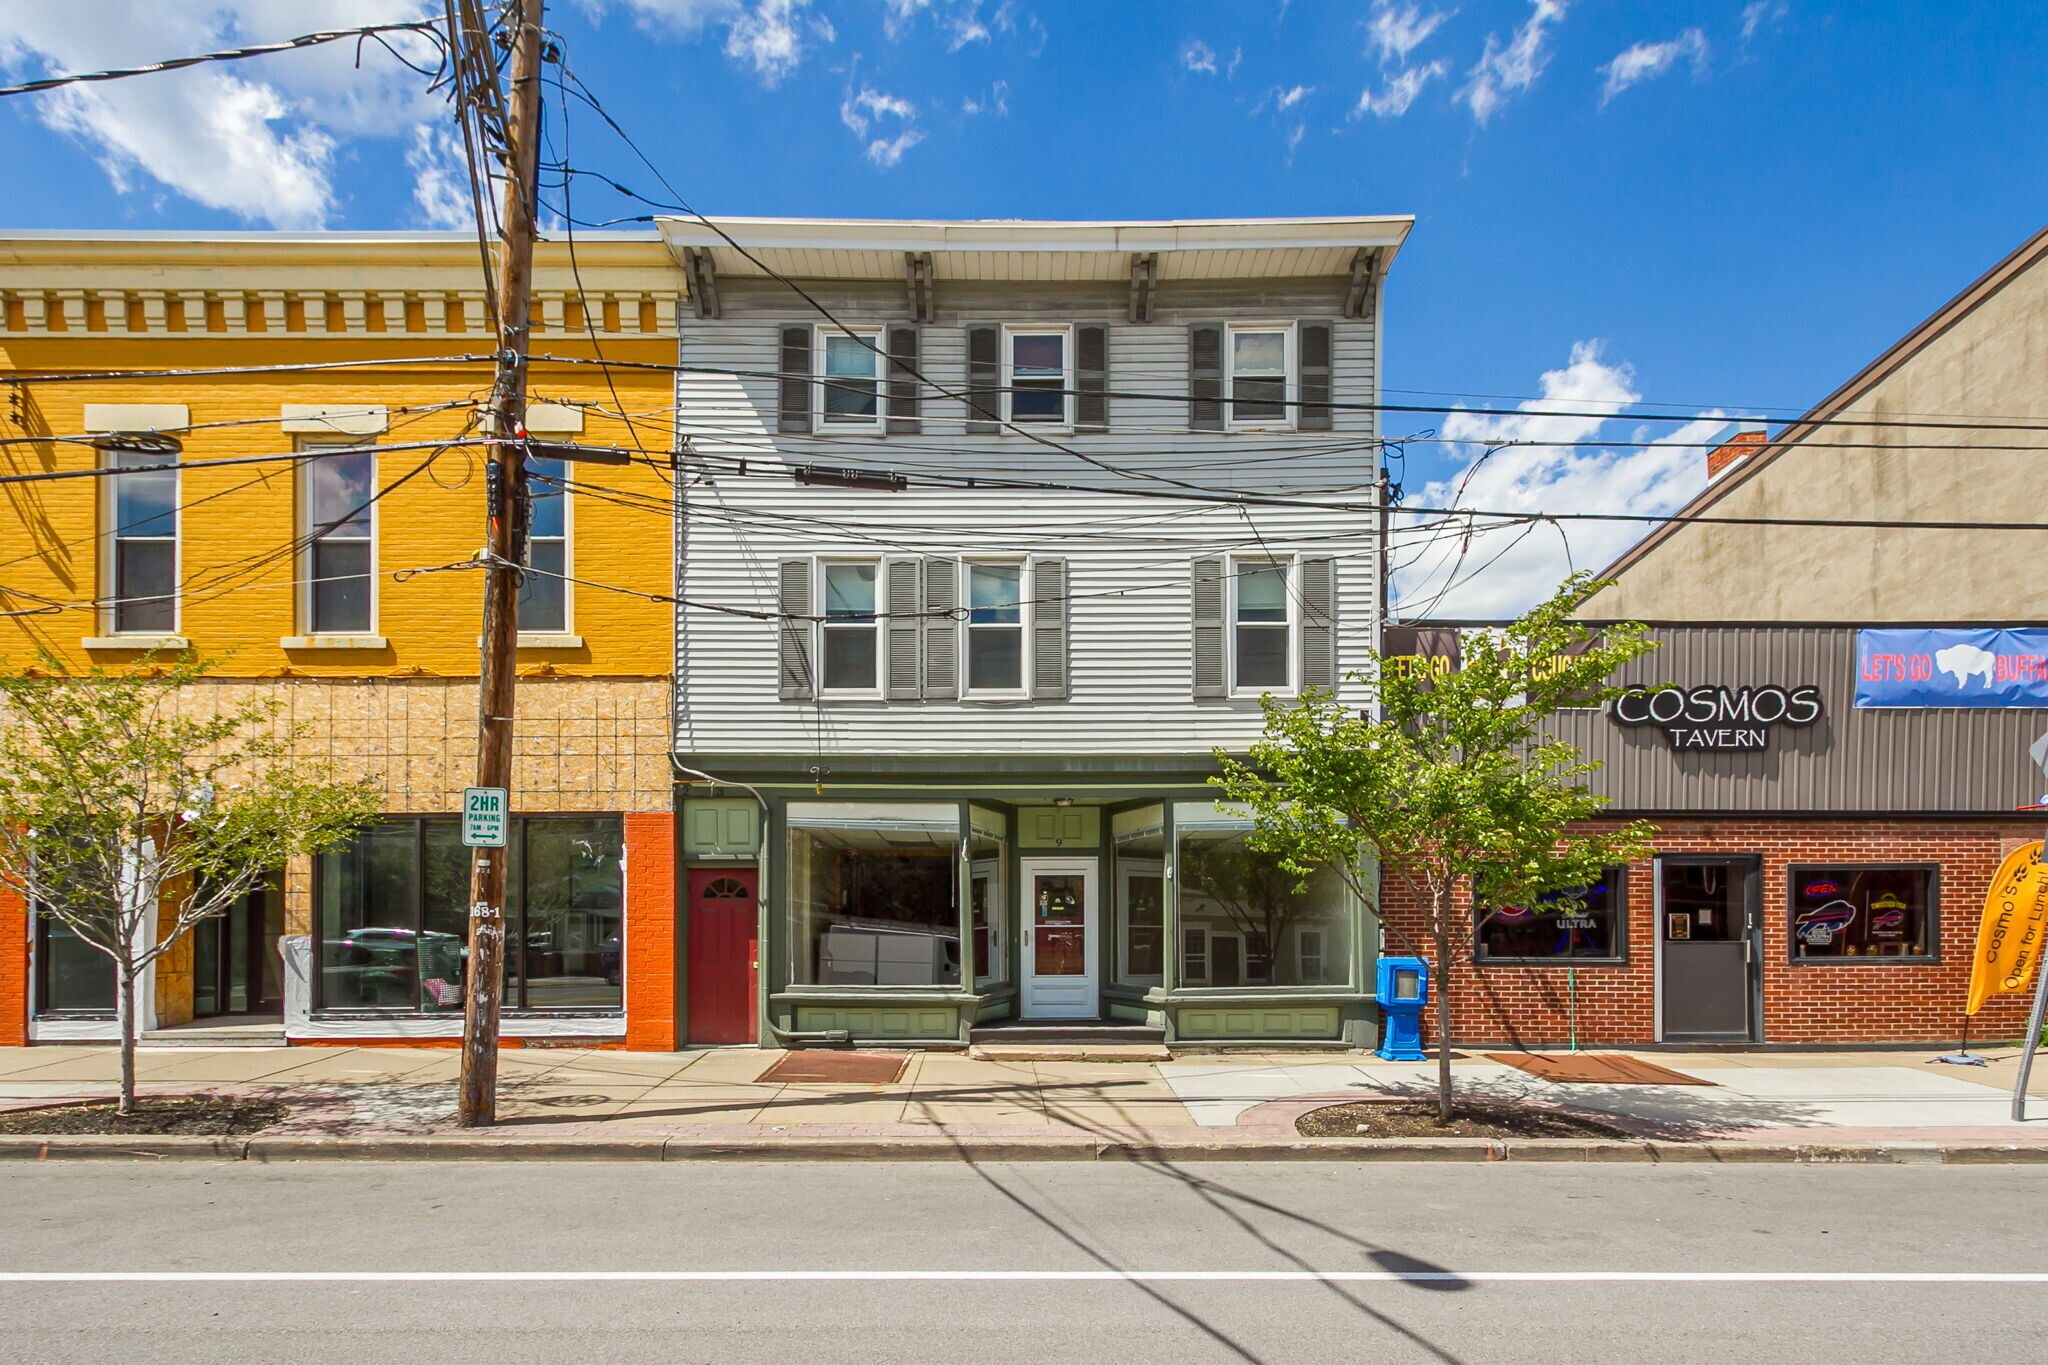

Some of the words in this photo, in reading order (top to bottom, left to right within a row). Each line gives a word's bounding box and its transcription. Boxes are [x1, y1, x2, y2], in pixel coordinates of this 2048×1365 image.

[1430, 655, 1450, 681] GO
[1862, 654, 1906, 681] LET'S
[1909, 654, 1932, 681] GO
[1617, 689, 1820, 722] COSMOS
[1669, 729, 1765, 747] TAVERN
[470, 795, 499, 811] 2HR
[468, 814, 500, 822] PARKING
[1056, 837, 1063, 847] 9
[1804, 883, 1838, 896] OPEN
[1556, 918, 1597, 929] ULTRA
[2004, 950, 2030, 989] Open
[2020, 924, 2036, 945] for
